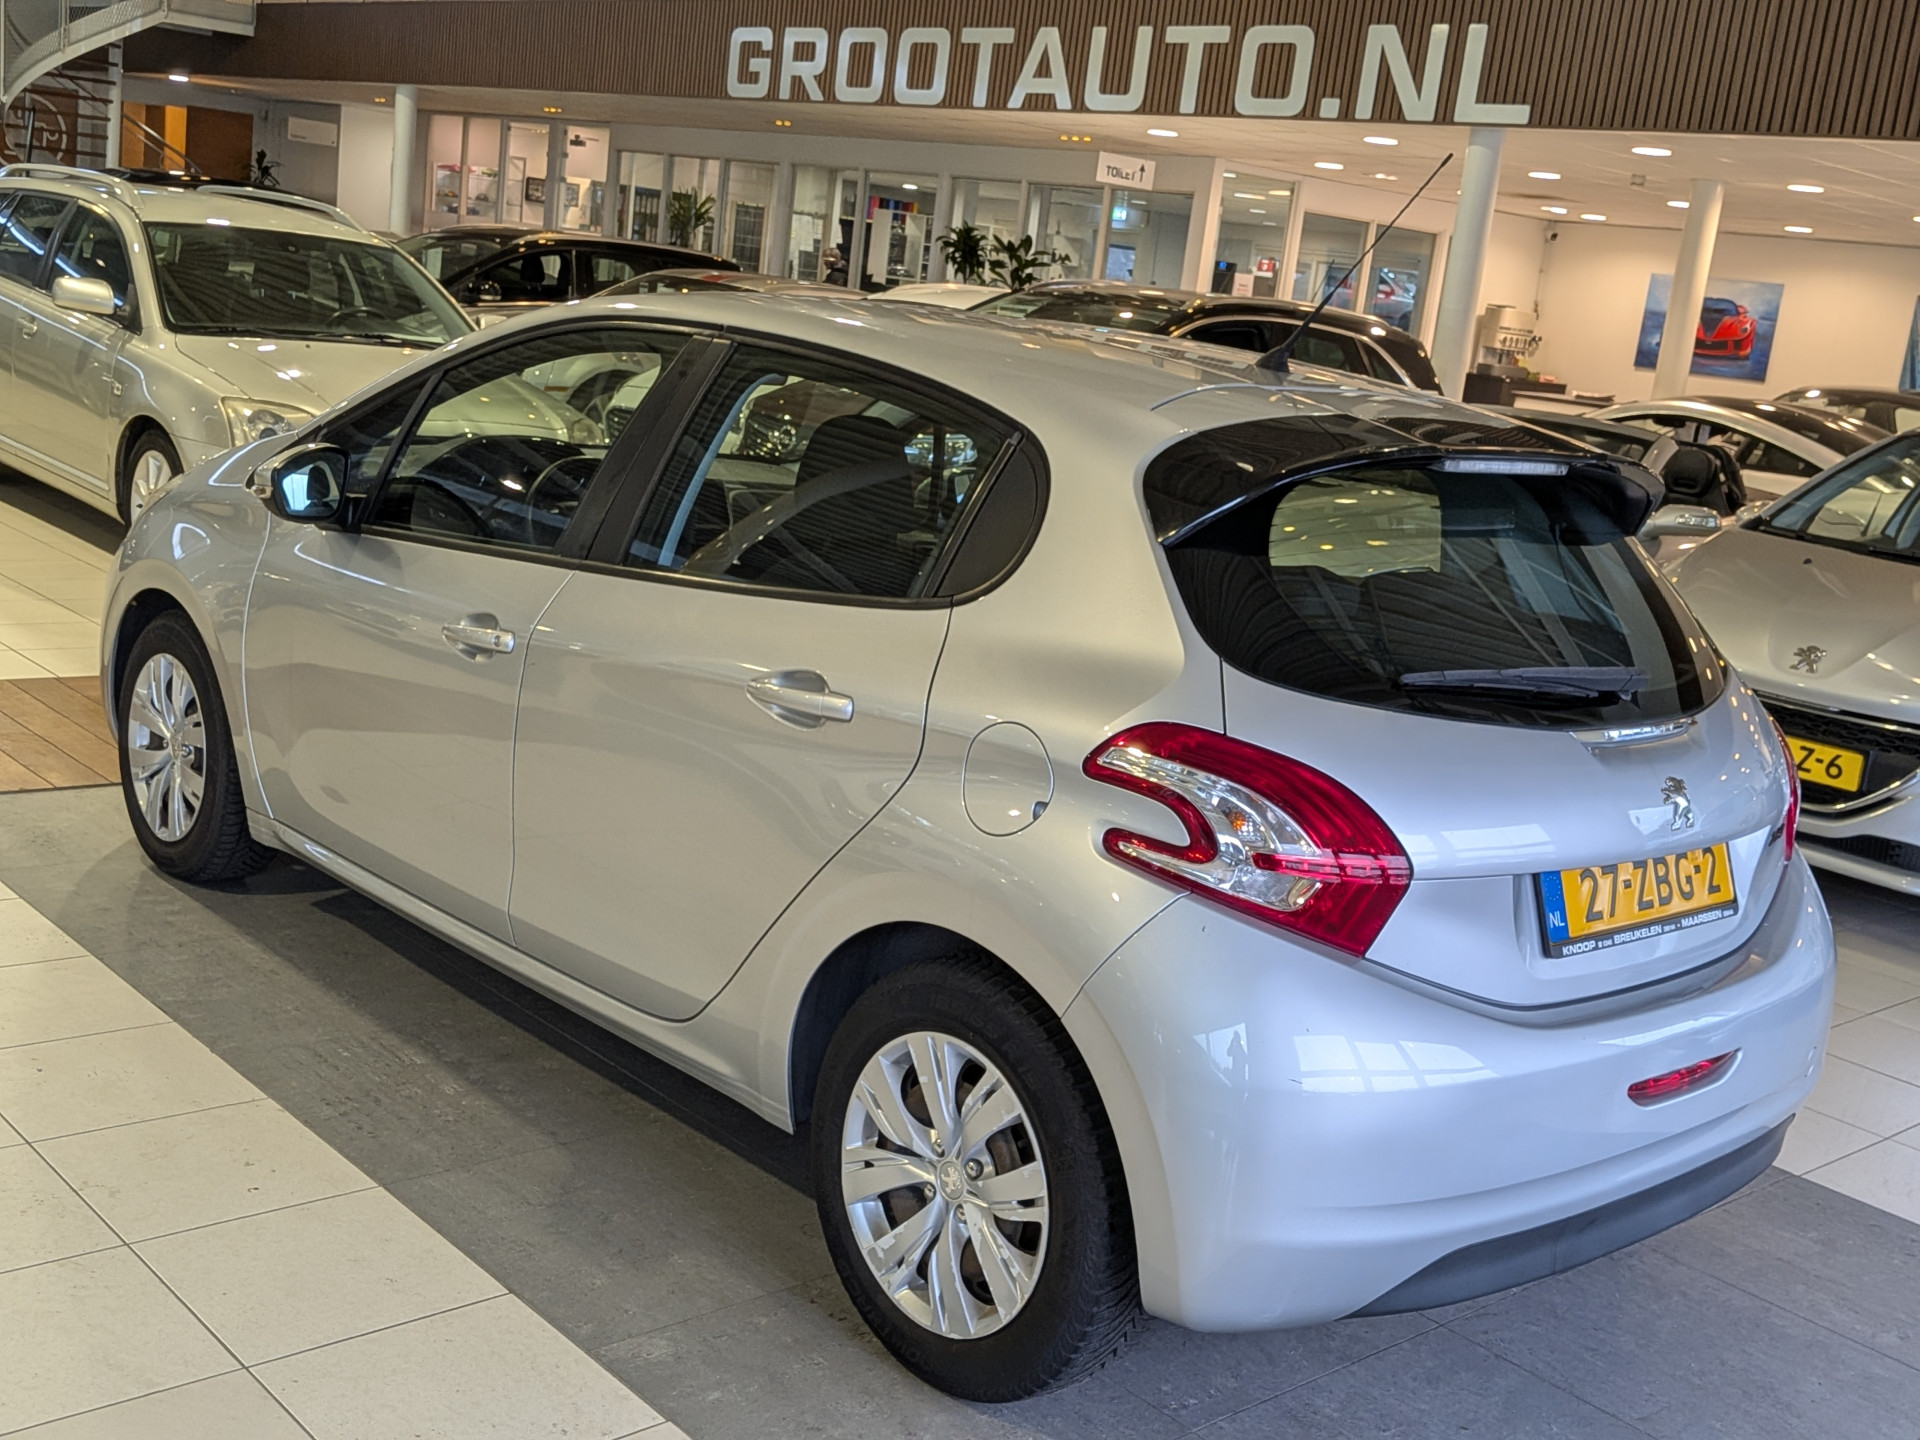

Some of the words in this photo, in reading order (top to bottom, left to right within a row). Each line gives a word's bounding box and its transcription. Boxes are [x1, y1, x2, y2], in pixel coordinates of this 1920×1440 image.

[727, 23, 1531, 125] GROOTAUTO.NL
[1106, 165, 1137, 181] TOILET
[1580, 847, 1721, 923] 27-ZBG-2
[1549, 911, 1565, 929] NL
[1562, 940, 1597, 956] KNOOP
[1613, 925, 1662, 945] BREUKELEN
[1681, 909, 1722, 928] MAARSSEN
